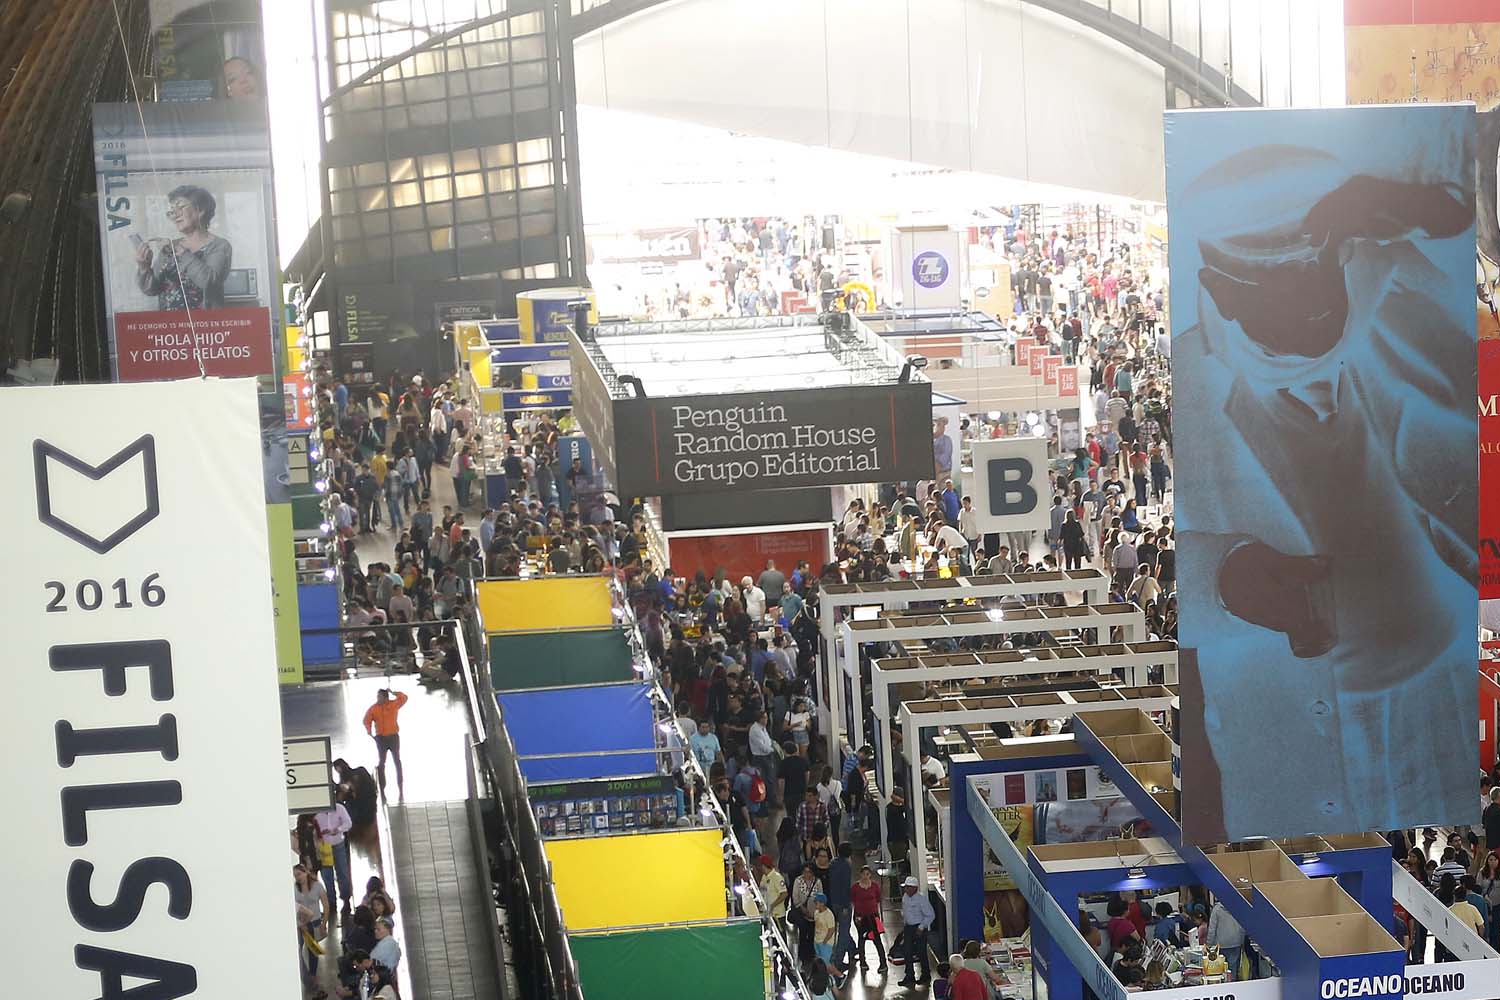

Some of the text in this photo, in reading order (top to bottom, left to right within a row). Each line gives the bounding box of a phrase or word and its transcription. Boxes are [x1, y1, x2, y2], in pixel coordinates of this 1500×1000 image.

[103, 153, 131, 232] FILSA
[348, 312, 358, 341] FILSA
[130, 345, 251, 362] Y OTROS RELATOS
[672, 402, 787, 431] Penguin
[674, 425, 876, 456] Random House
[674, 448, 880, 485] Grupo Editorial
[988, 457, 1037, 516] B
[44, 573, 167, 612] 2016
[1321, 974, 1401, 999] OCEANO
[1403, 973, 1465, 995] OCEANO
